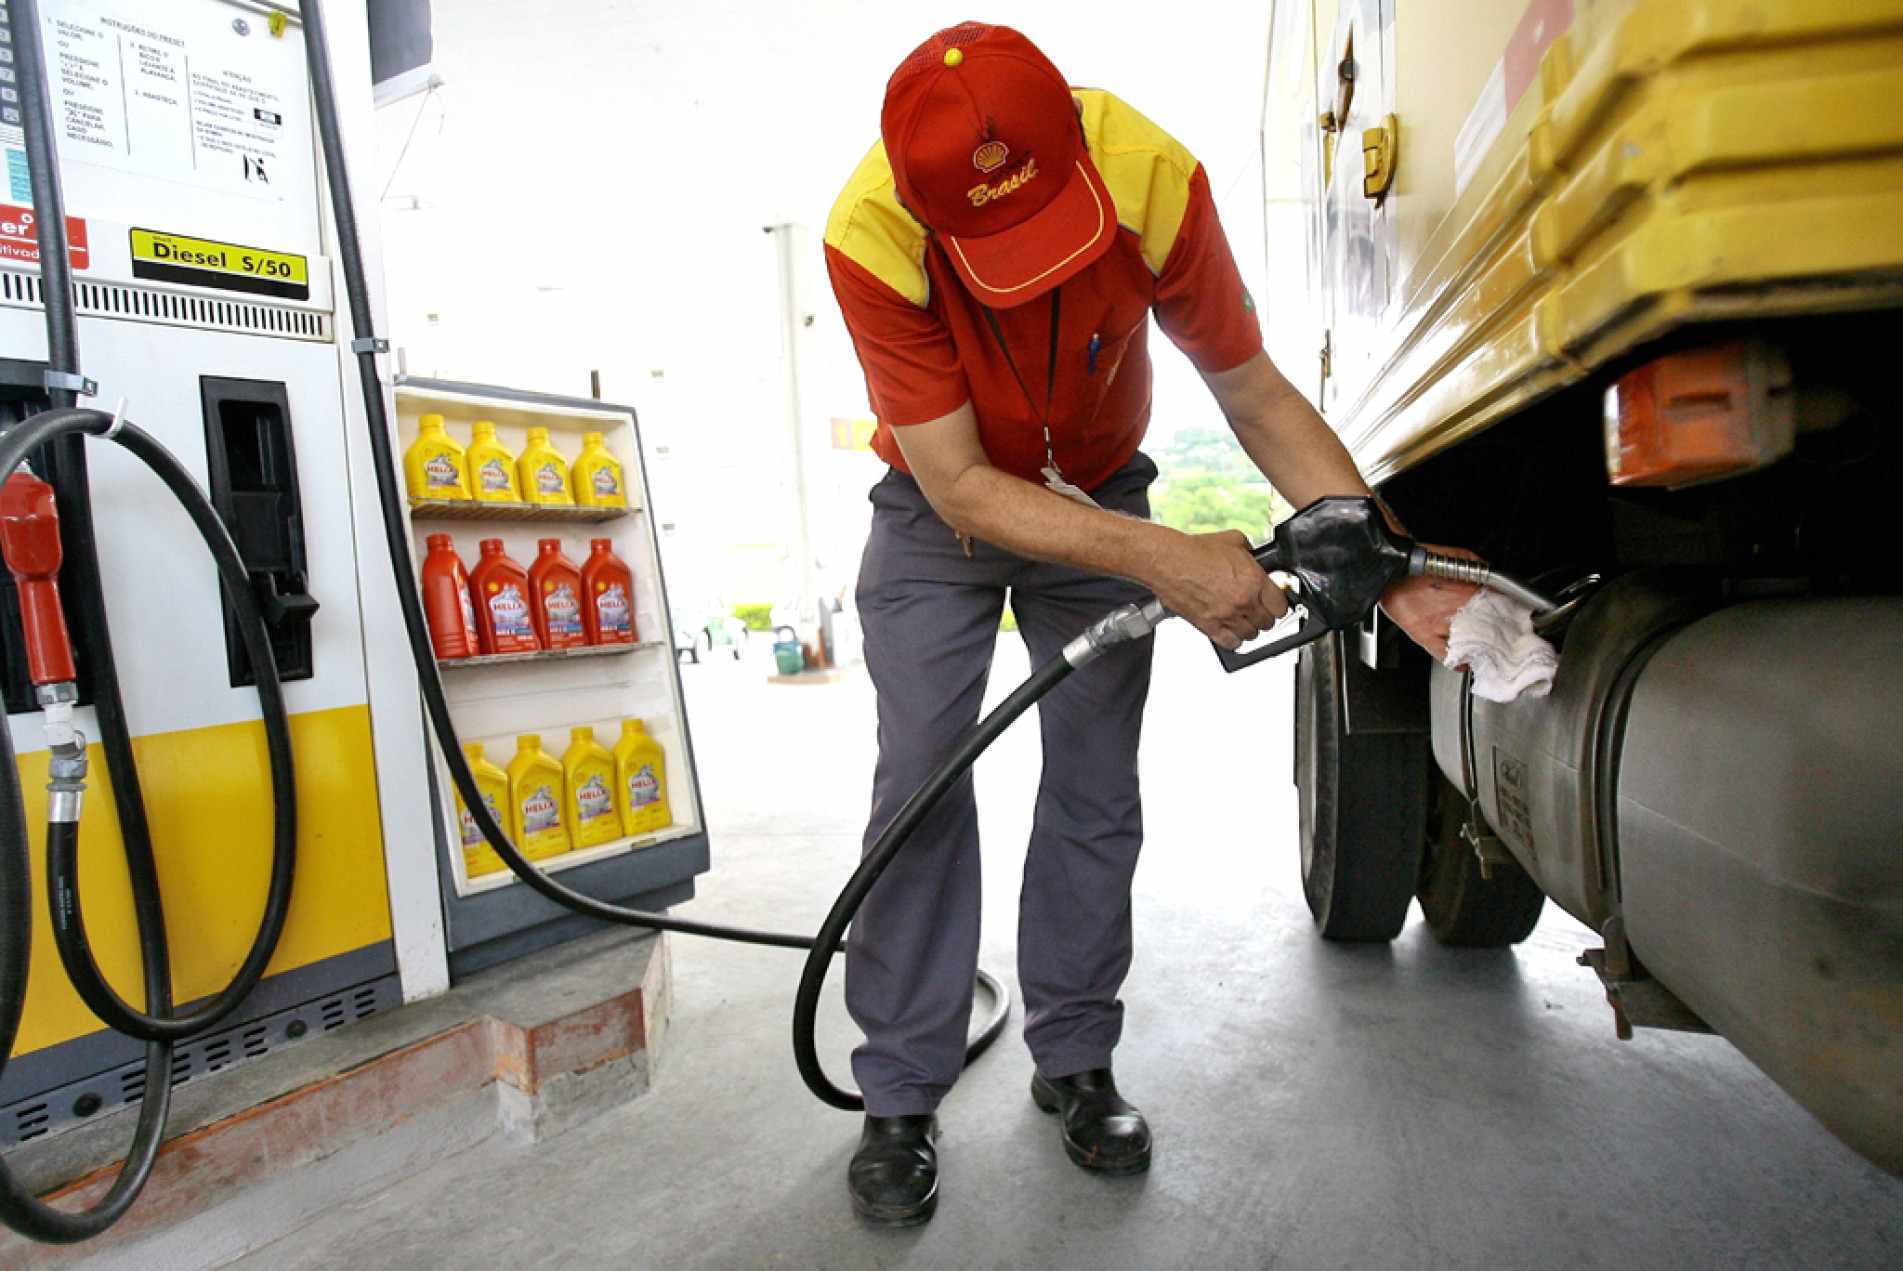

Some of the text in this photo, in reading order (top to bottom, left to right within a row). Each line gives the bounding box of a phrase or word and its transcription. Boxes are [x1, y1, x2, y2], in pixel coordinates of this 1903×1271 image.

[968, 157, 1040, 208] Brasil
[153, 242, 291, 278] Diesel S/50
[525, 799, 553, 815] HELIX
